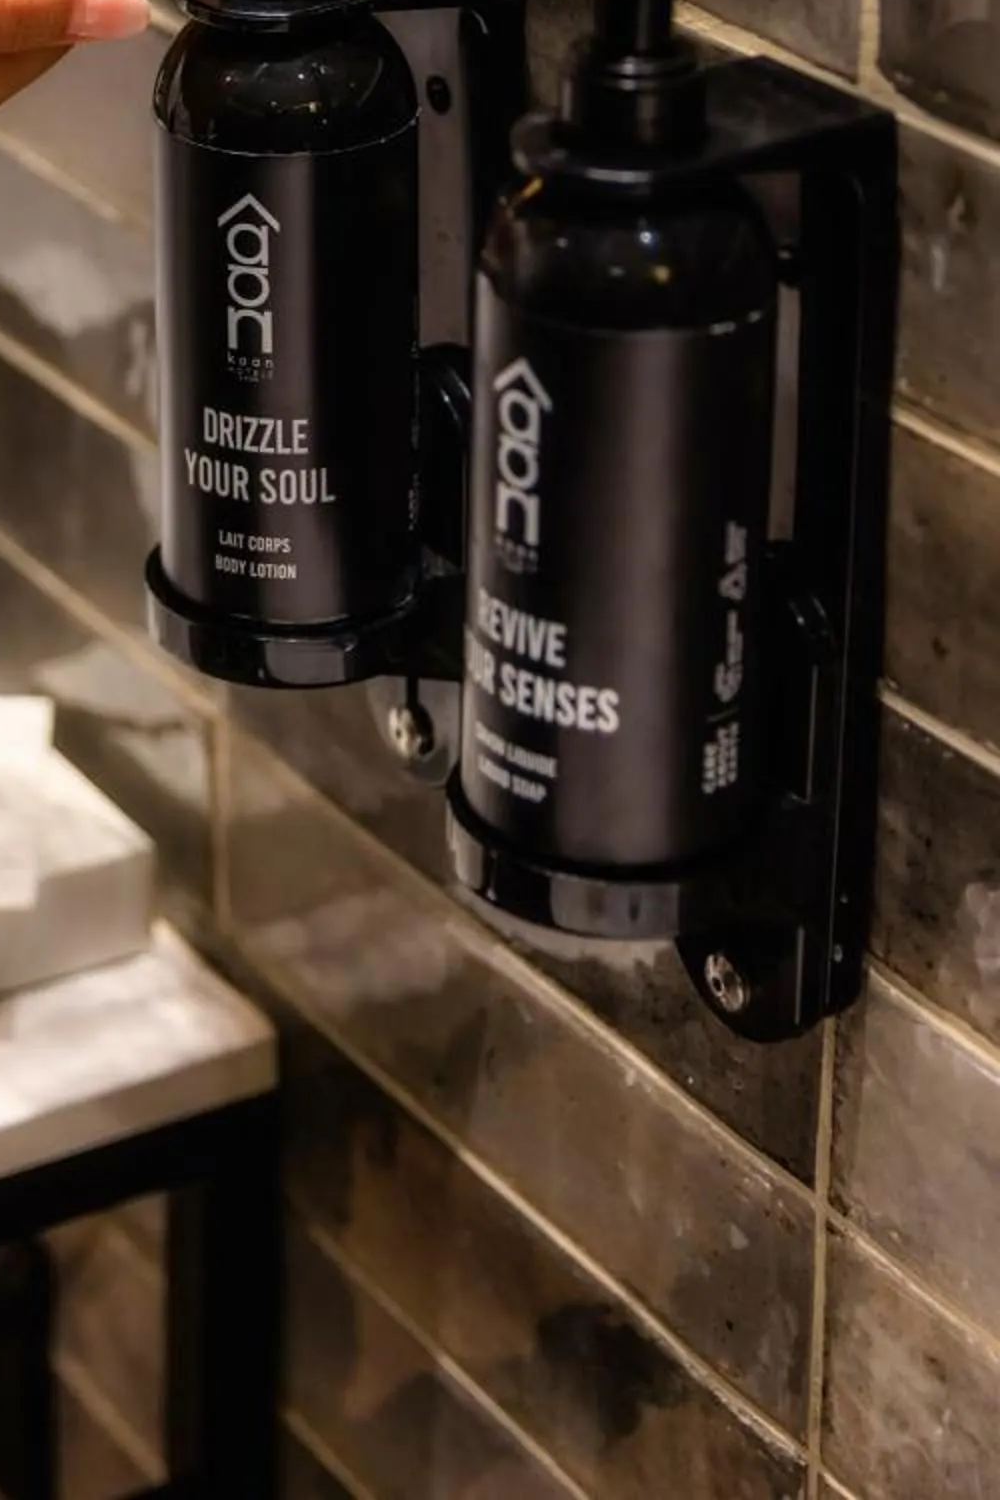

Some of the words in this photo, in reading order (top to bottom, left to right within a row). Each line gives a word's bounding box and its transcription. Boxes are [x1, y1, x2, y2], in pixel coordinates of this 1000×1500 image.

[203, 406, 309, 455] DRIZZLE
[184, 448, 250, 502] YOUR
[259, 466, 337, 505] SOUL
[218, 529, 245, 549] LAIT
[248, 536, 293, 553] CORPS
[215, 553, 247, 575] BODY
[250, 561, 298, 580] LOTION
[500, 662, 621, 733] SENSES
